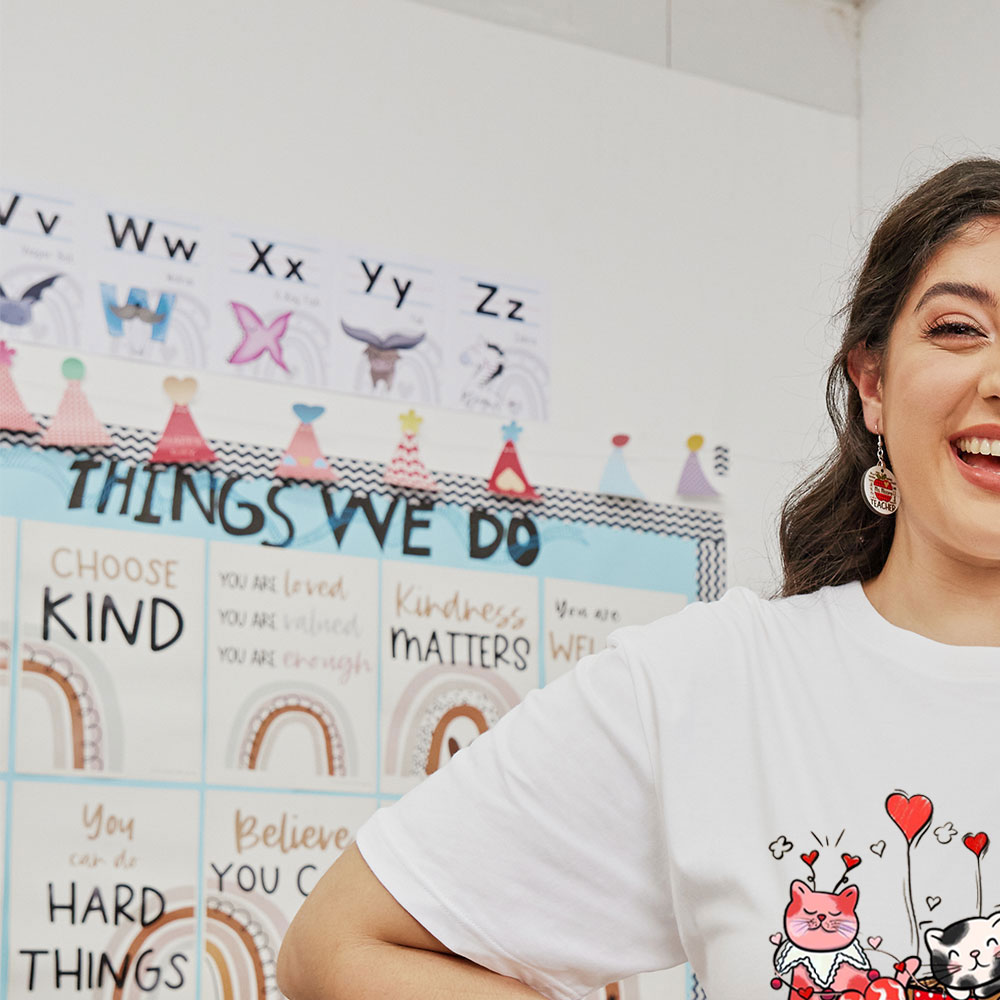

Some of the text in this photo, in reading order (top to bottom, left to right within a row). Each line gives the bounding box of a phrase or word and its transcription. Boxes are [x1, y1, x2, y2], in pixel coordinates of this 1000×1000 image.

[67, 459, 541, 567] THINGS WE DO
[51, 547, 178, 589] CHOOSE
[284, 569, 348, 601] loved
[43, 586, 184, 652] KIND
[395, 581, 527, 630] Kindness
[282, 651, 373, 685] enough
[81, 803, 135, 841] You
[234, 809, 351, 855] Believe
[210, 861, 280, 895] YOU
[48, 881, 166, 928] HARD
[19, 947, 189, 992] THINGS
